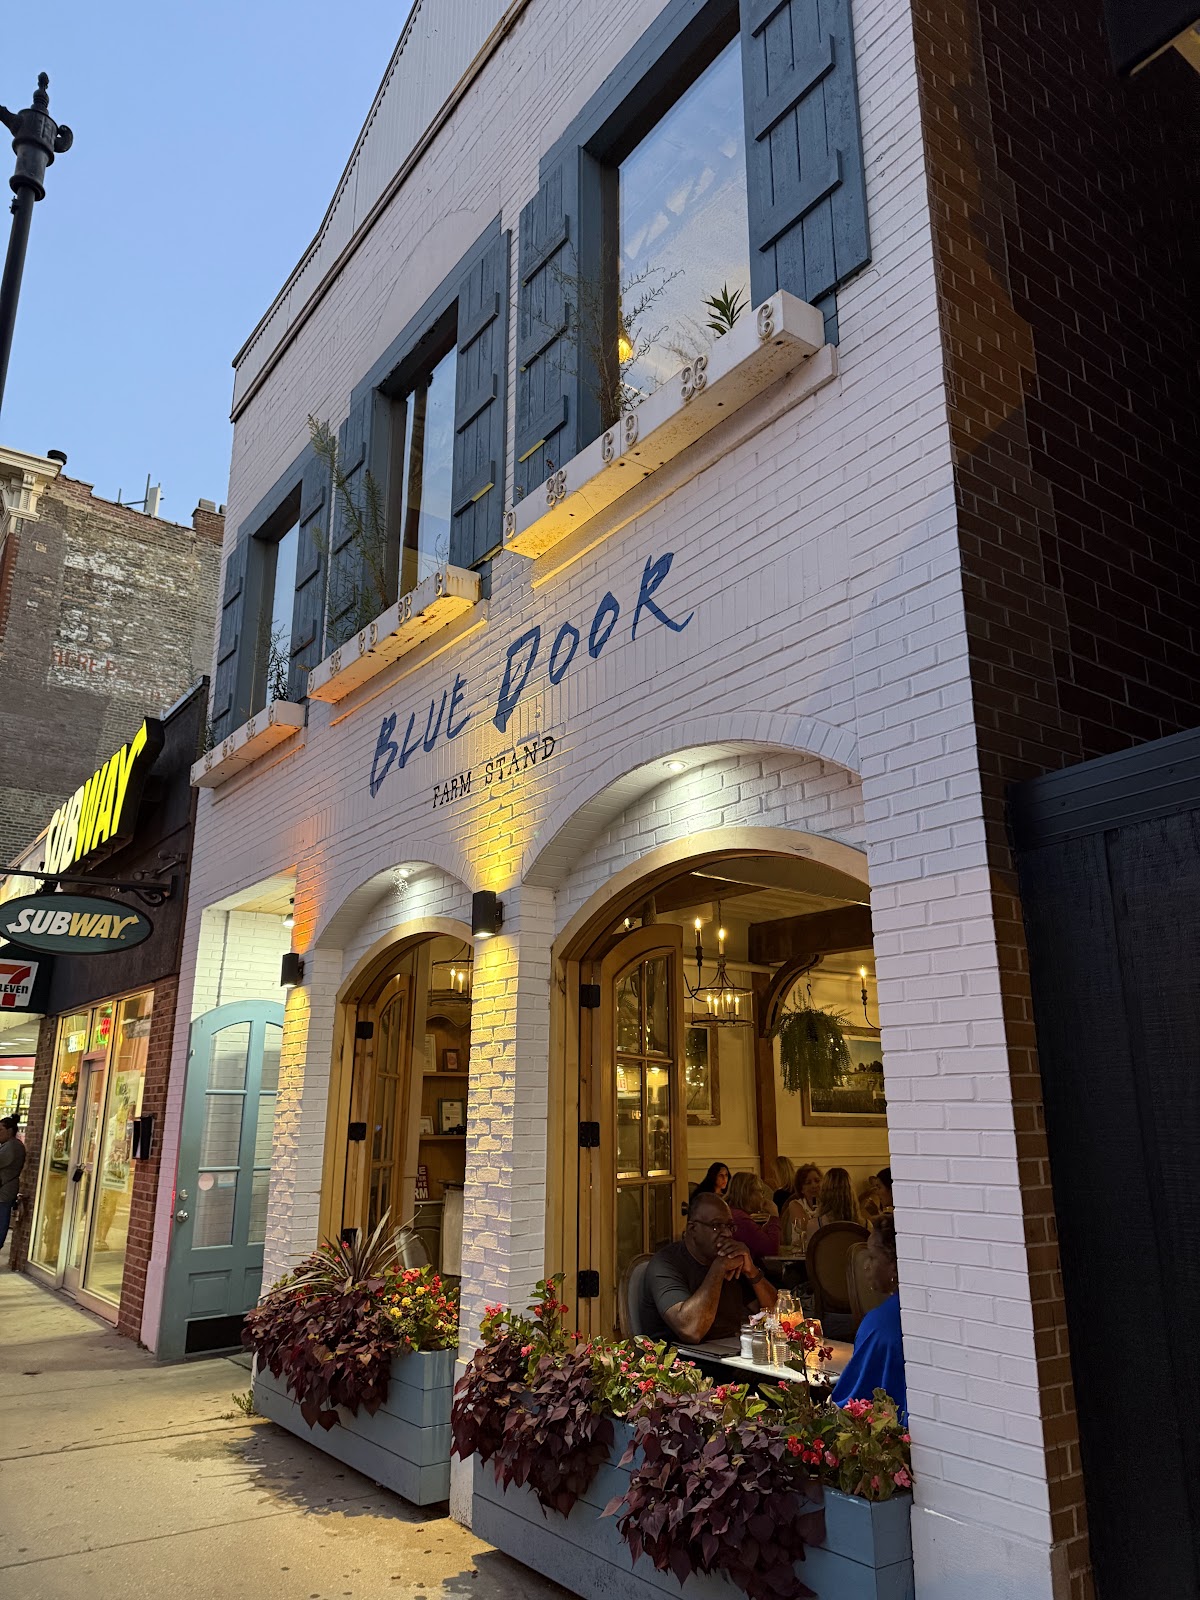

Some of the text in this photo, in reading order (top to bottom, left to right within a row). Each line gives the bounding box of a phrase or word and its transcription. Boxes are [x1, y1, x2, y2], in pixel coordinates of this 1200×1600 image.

[369, 552, 695, 799] BLUE DOOR
[42, 719, 148, 876] SUBWAY
[432, 735, 556, 808] FARM STAND
[6, 908, 140, 940] SUBWAY
